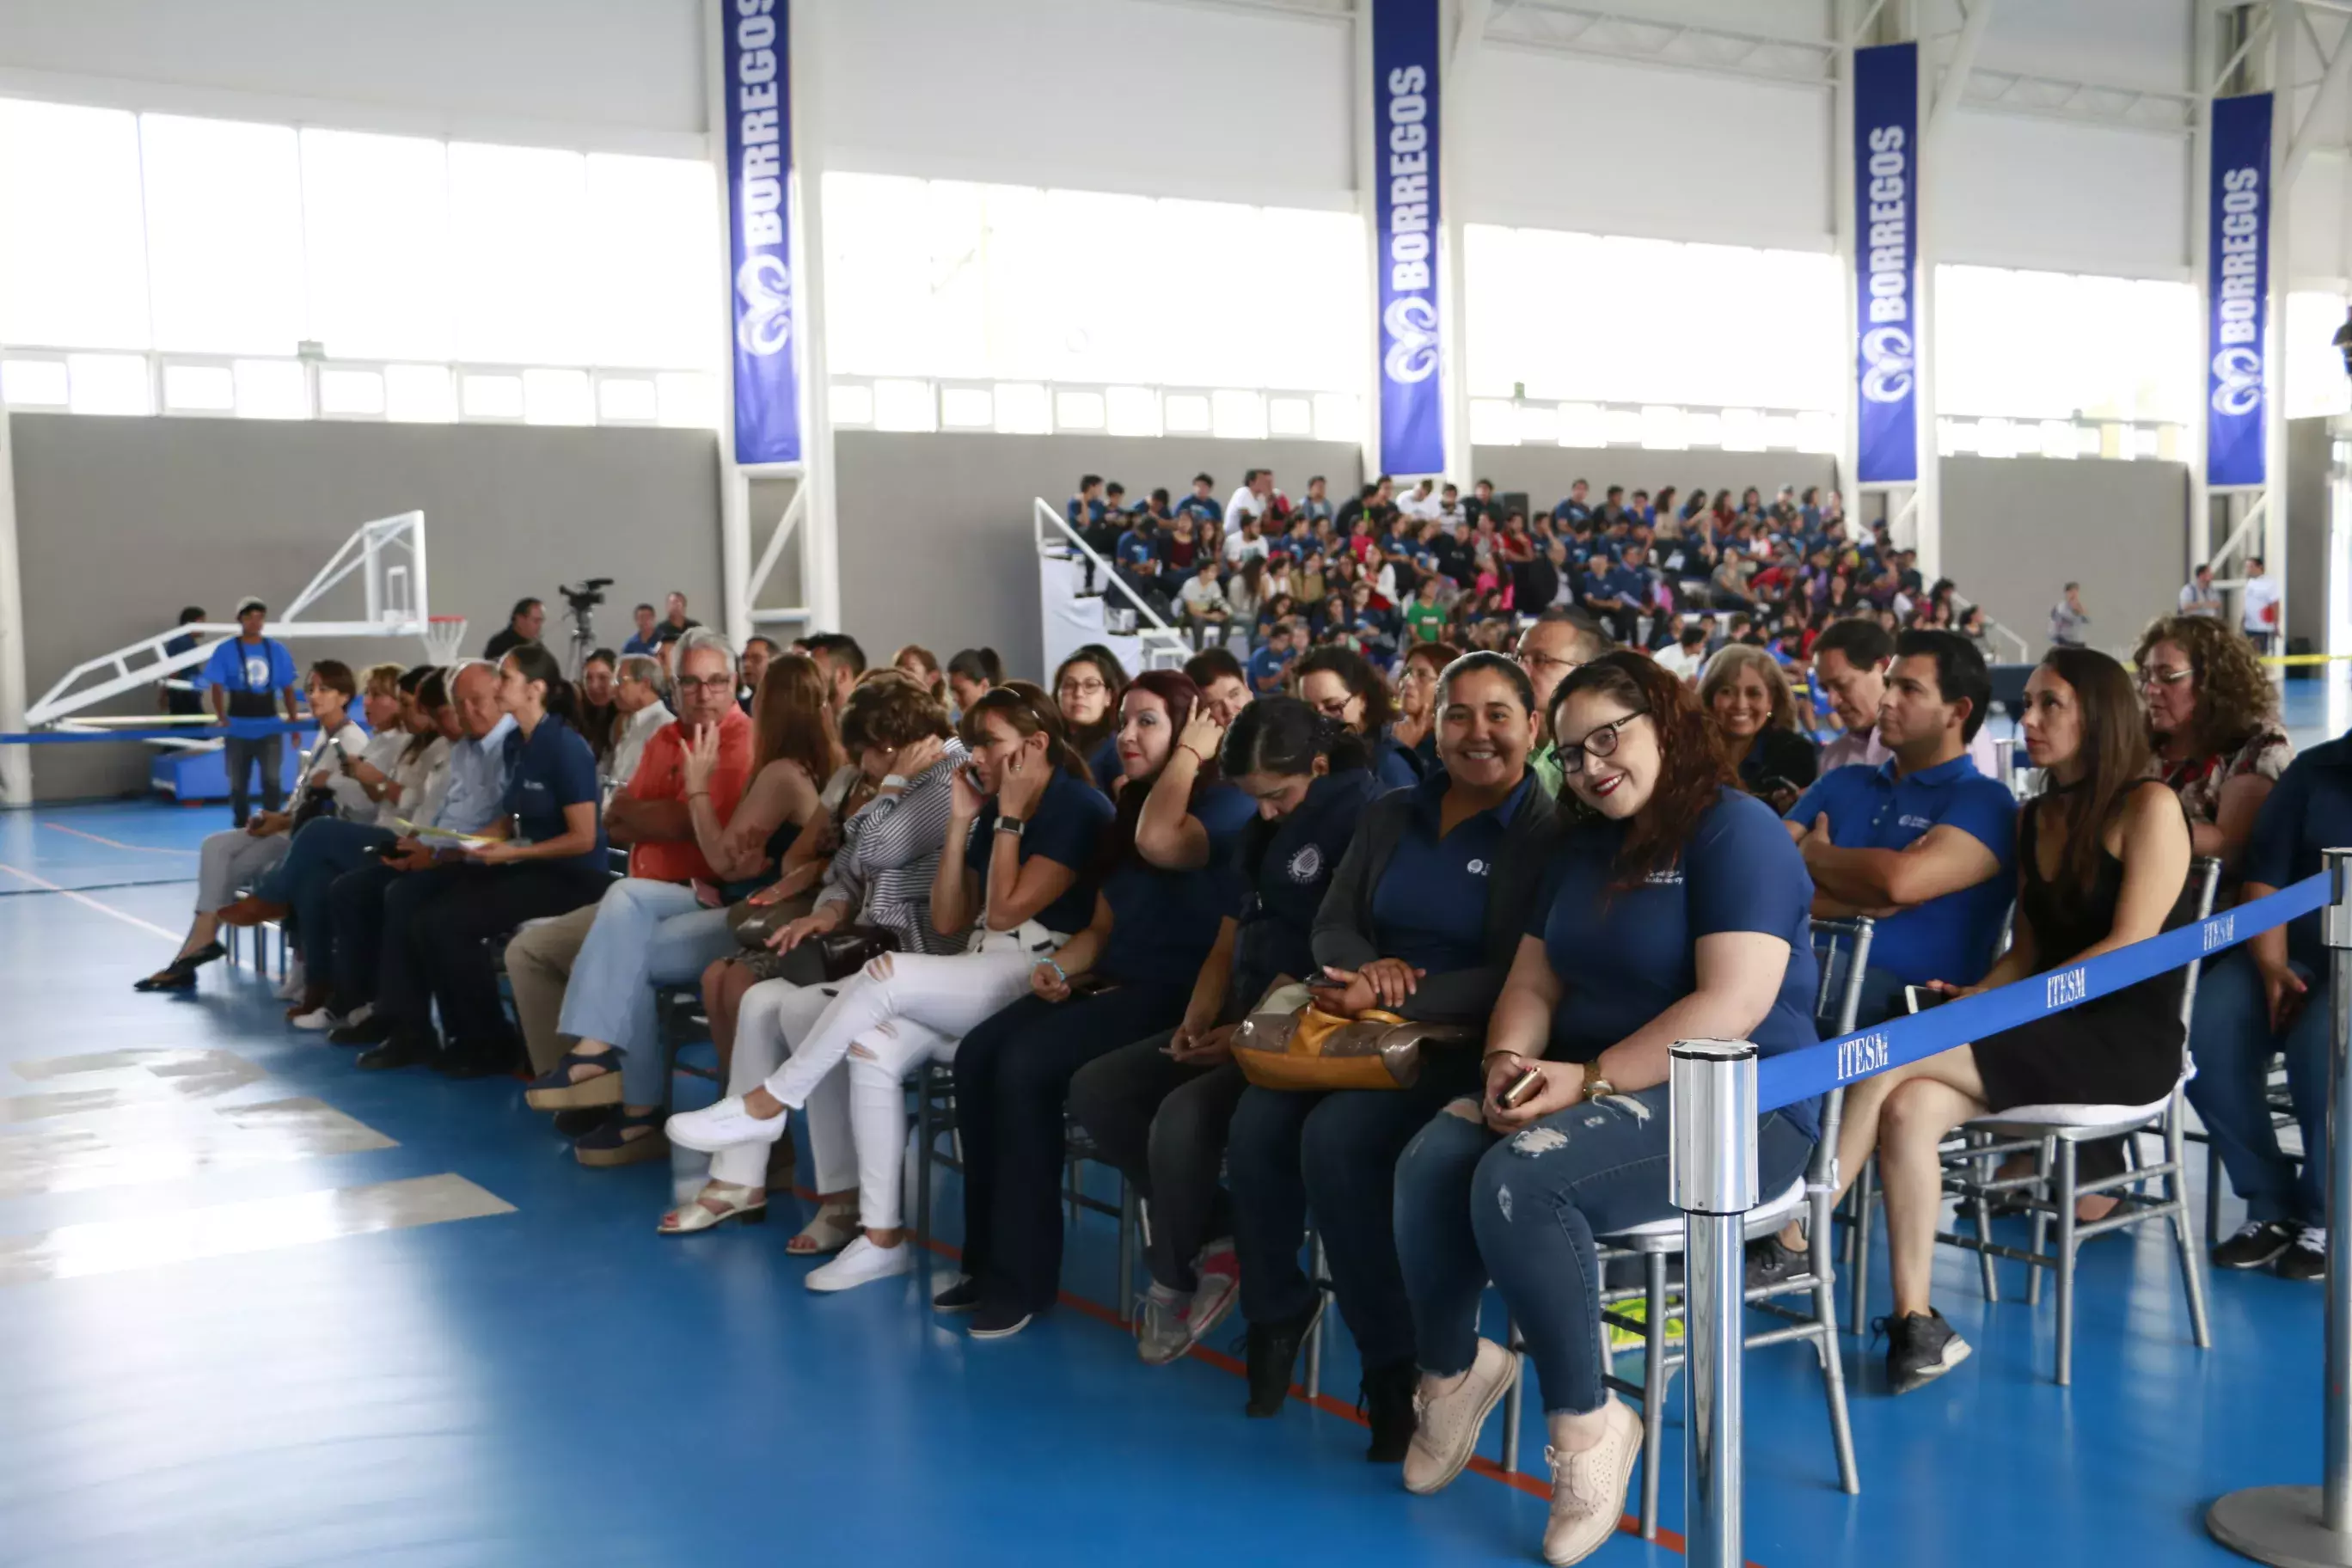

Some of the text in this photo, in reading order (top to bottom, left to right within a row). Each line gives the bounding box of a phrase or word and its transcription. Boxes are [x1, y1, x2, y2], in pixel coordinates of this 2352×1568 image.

[1388, 64, 1430, 291] BORREGOS
[1869, 125, 1907, 323] BORREGOS
[2220, 168, 2258, 345] BORREGOS
[2047, 966, 2086, 1008] ITESM
[2203, 914, 2234, 952] ITESM
[1837, 1031, 1890, 1081] ITESM
